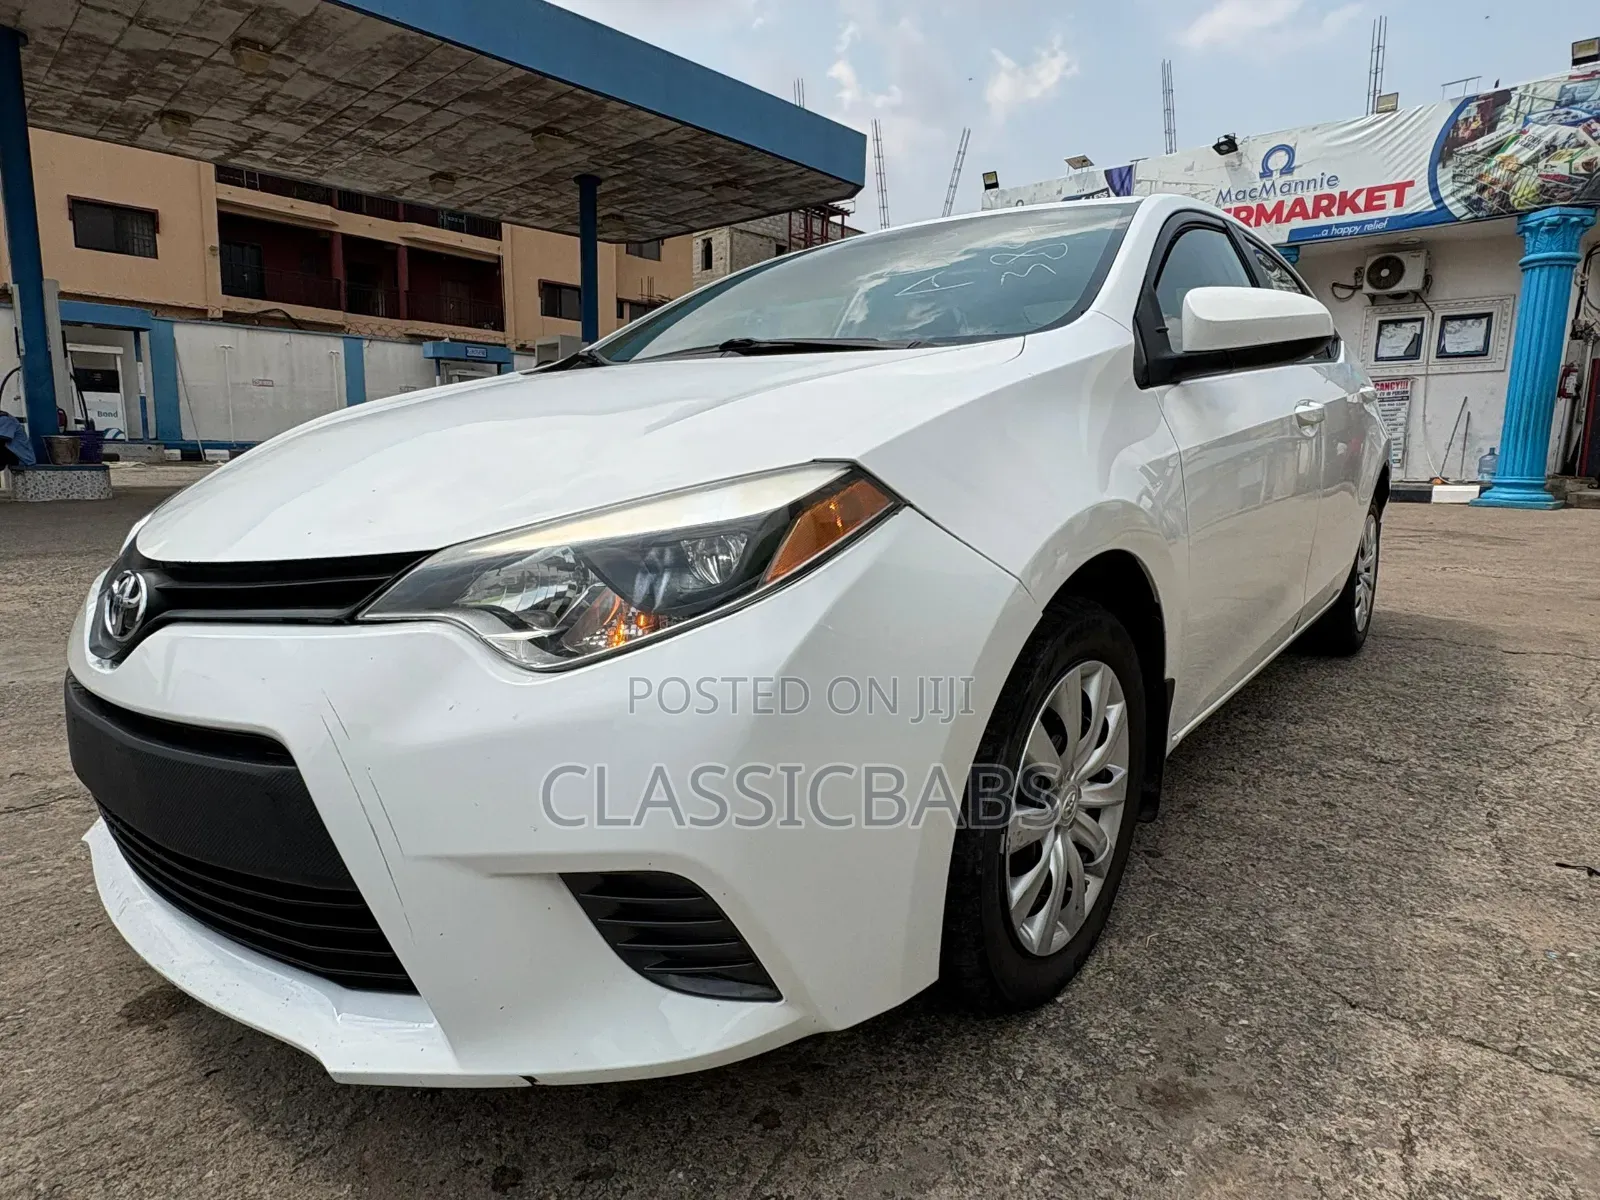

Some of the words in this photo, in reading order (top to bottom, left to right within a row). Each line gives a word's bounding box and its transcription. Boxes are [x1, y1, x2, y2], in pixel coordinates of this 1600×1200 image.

[1214, 172, 1340, 205] MacMannie
[1330, 224, 1362, 237] happy
[1363, 217, 1390, 231] relief
[97, 410, 118, 418] Bond
